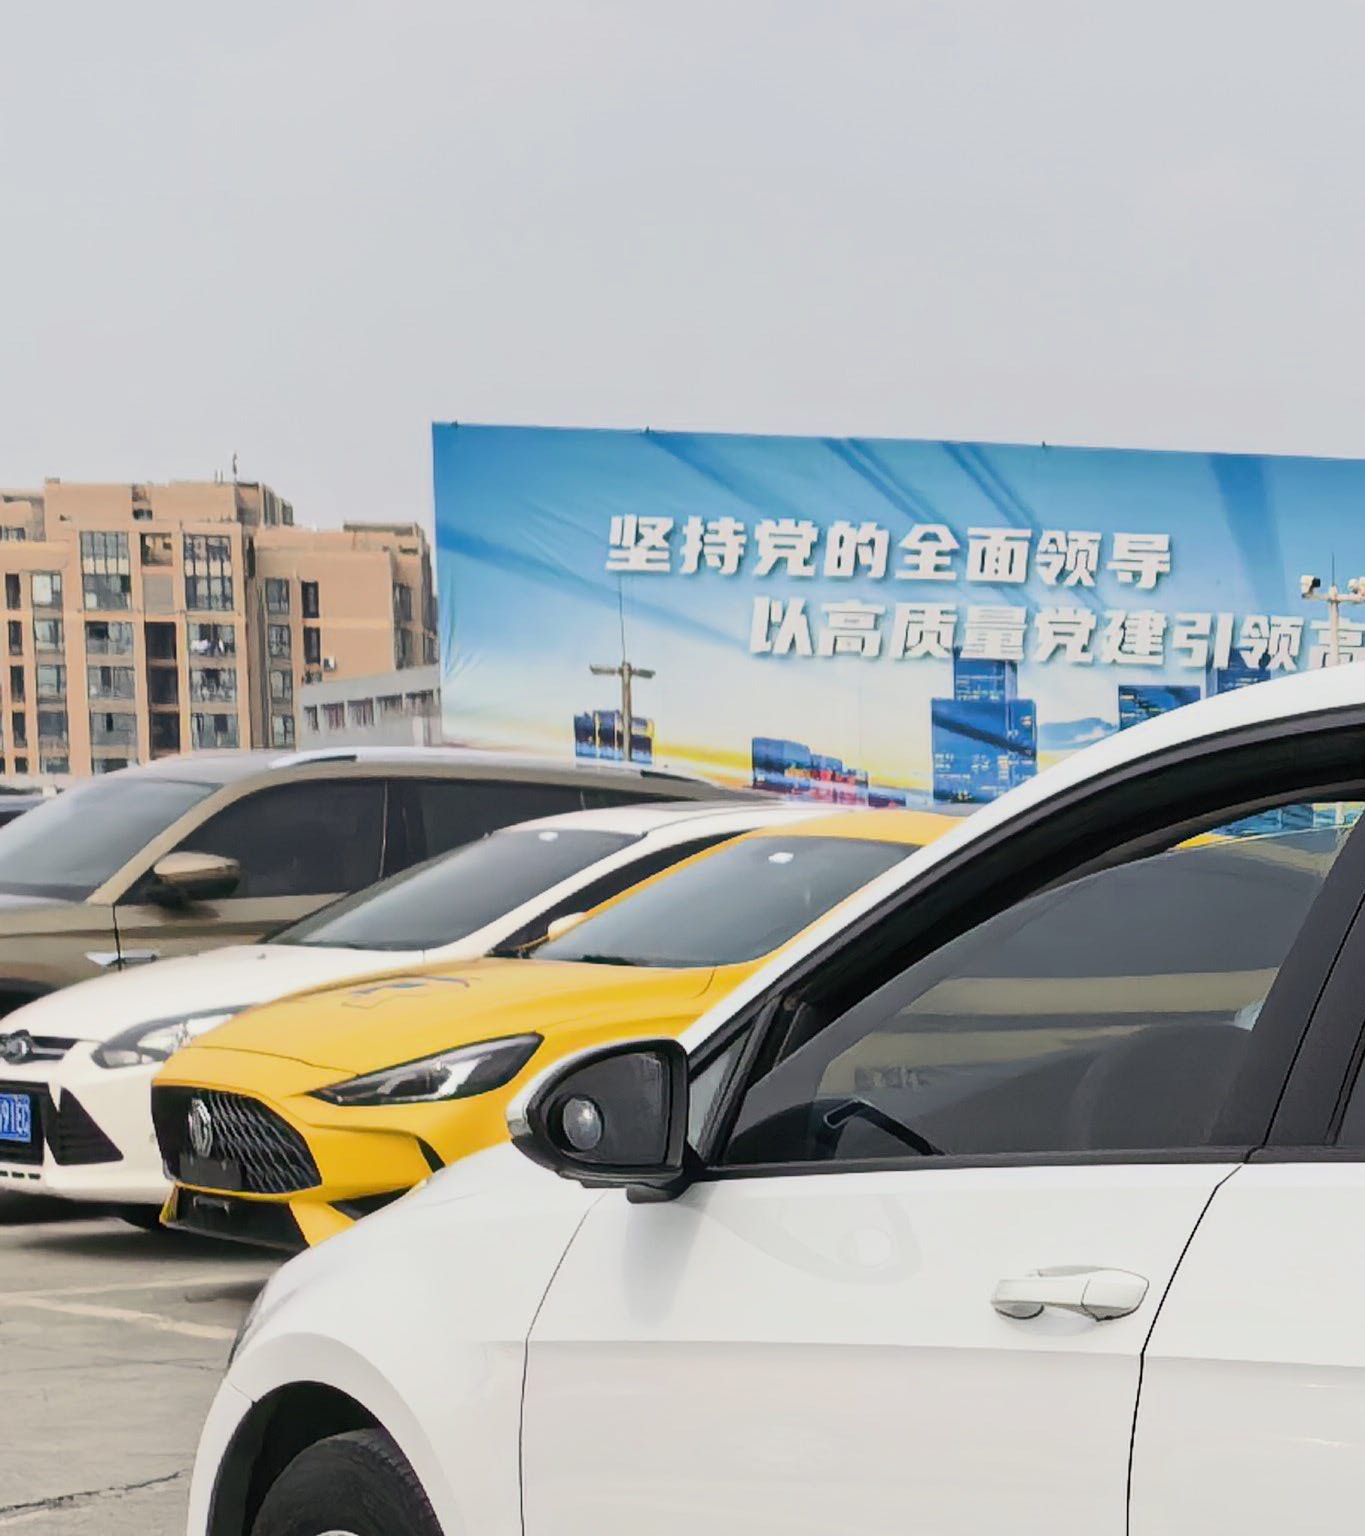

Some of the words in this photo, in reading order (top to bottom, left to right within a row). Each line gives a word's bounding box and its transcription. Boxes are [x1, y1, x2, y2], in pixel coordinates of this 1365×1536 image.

[606, 514, 1171, 589] 坚持党的全面领导
